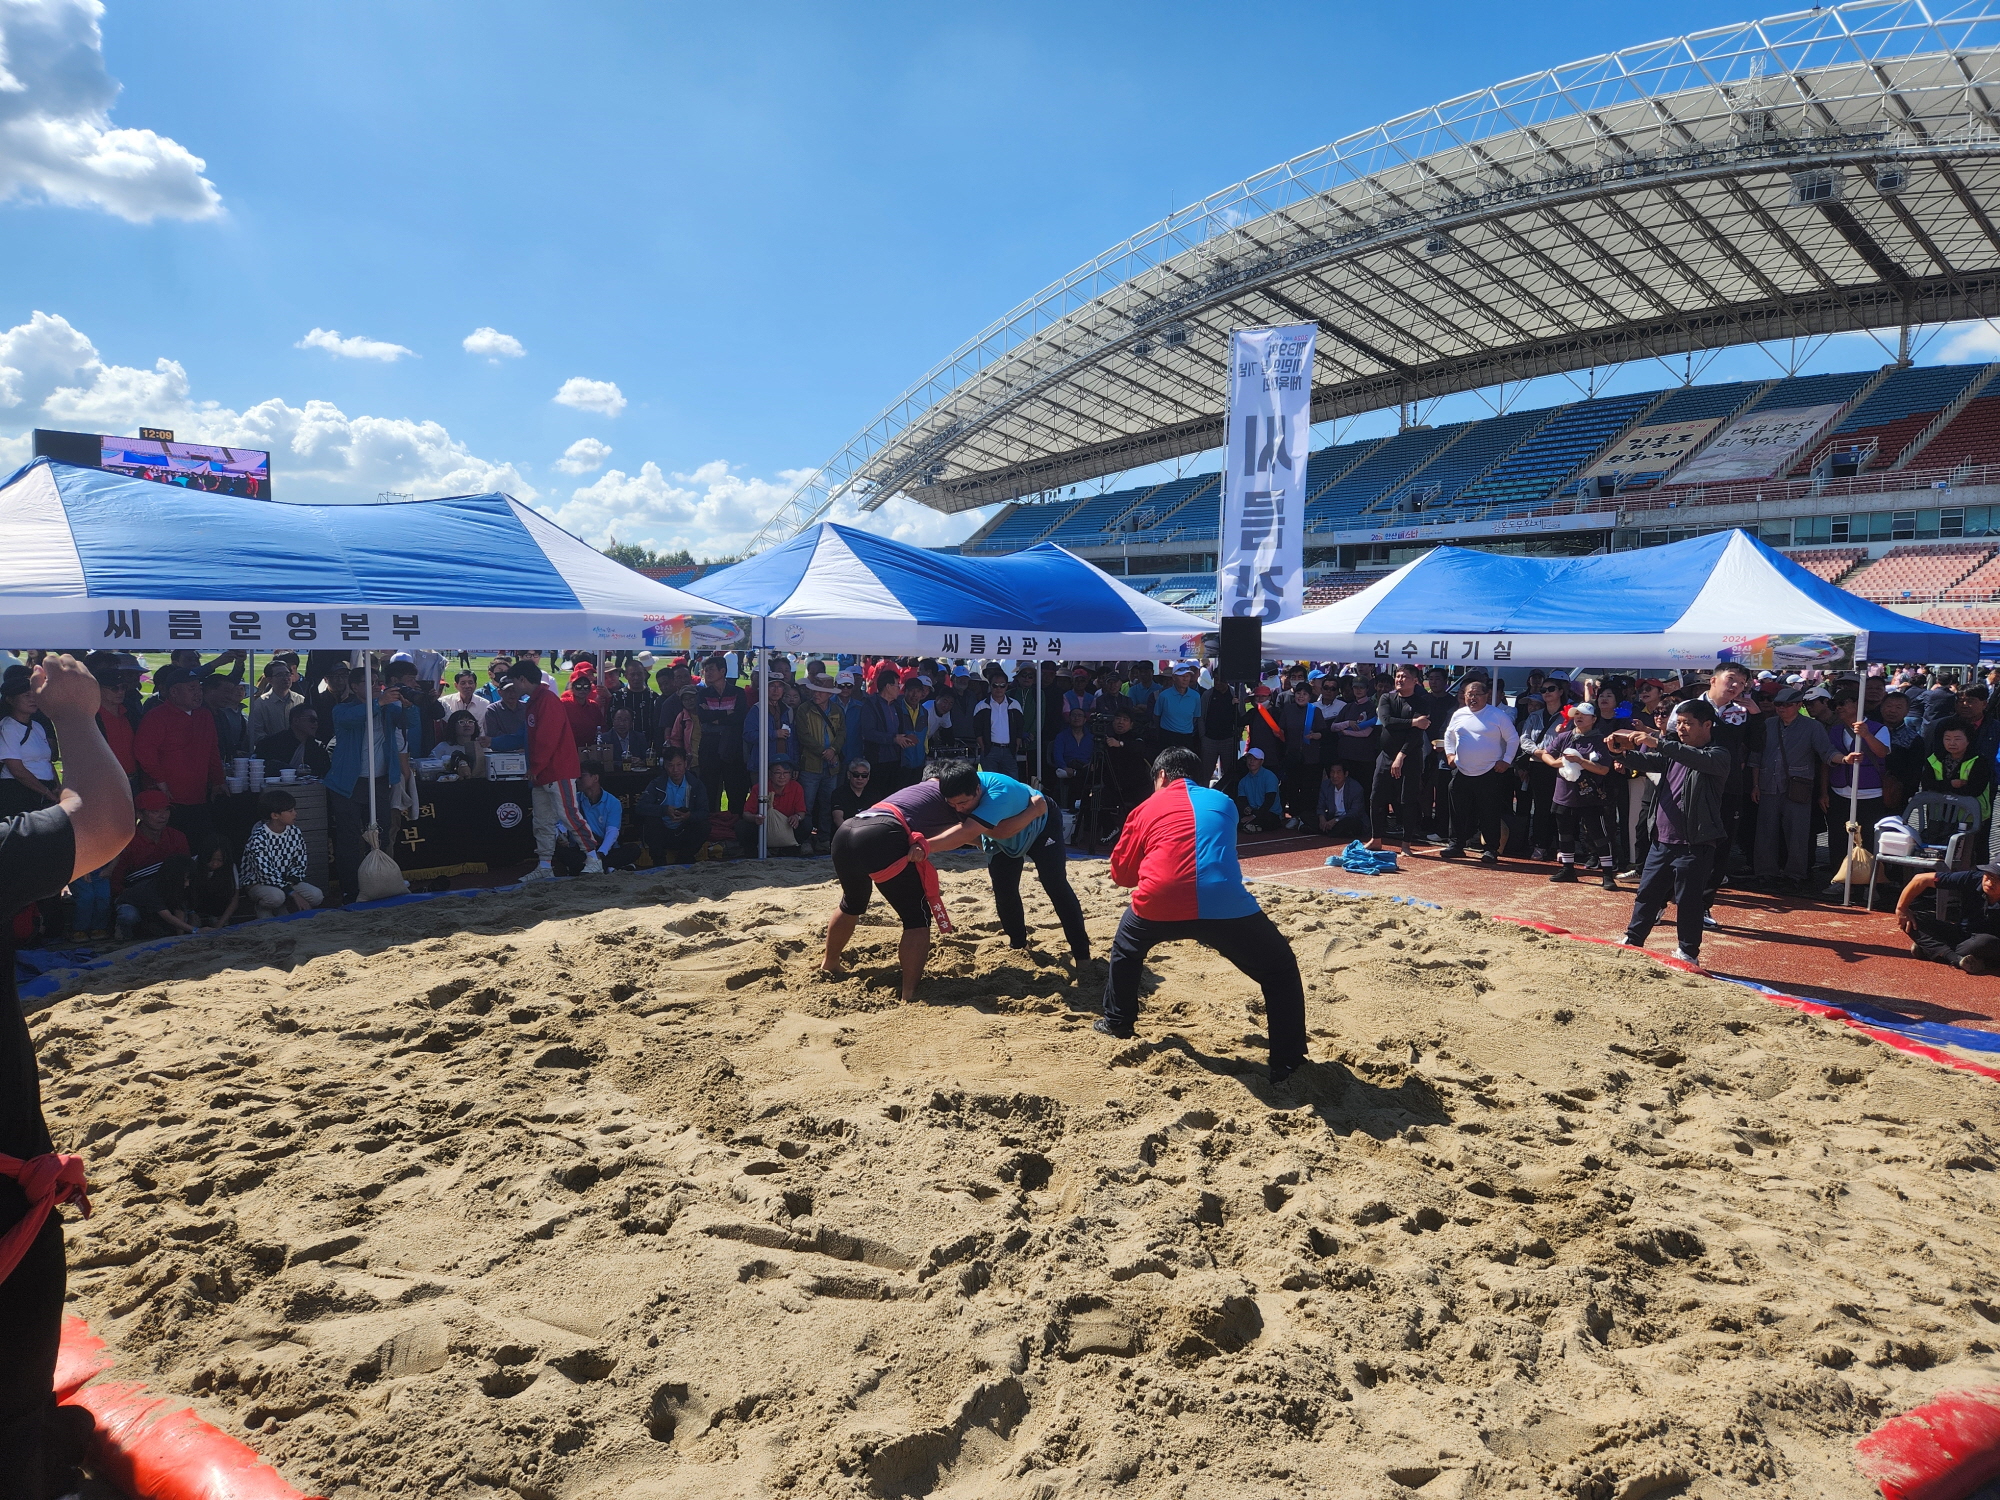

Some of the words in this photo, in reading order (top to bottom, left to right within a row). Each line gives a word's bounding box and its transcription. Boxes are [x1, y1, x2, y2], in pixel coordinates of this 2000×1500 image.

[143, 429, 172, 439] 12:09
[643, 614, 666, 622] 2024
[654, 625, 673, 635] 안산
[652, 632, 684, 647] 페스타
[1722, 635, 1747, 643] 2024
[1732, 645, 1753, 655] 안산
